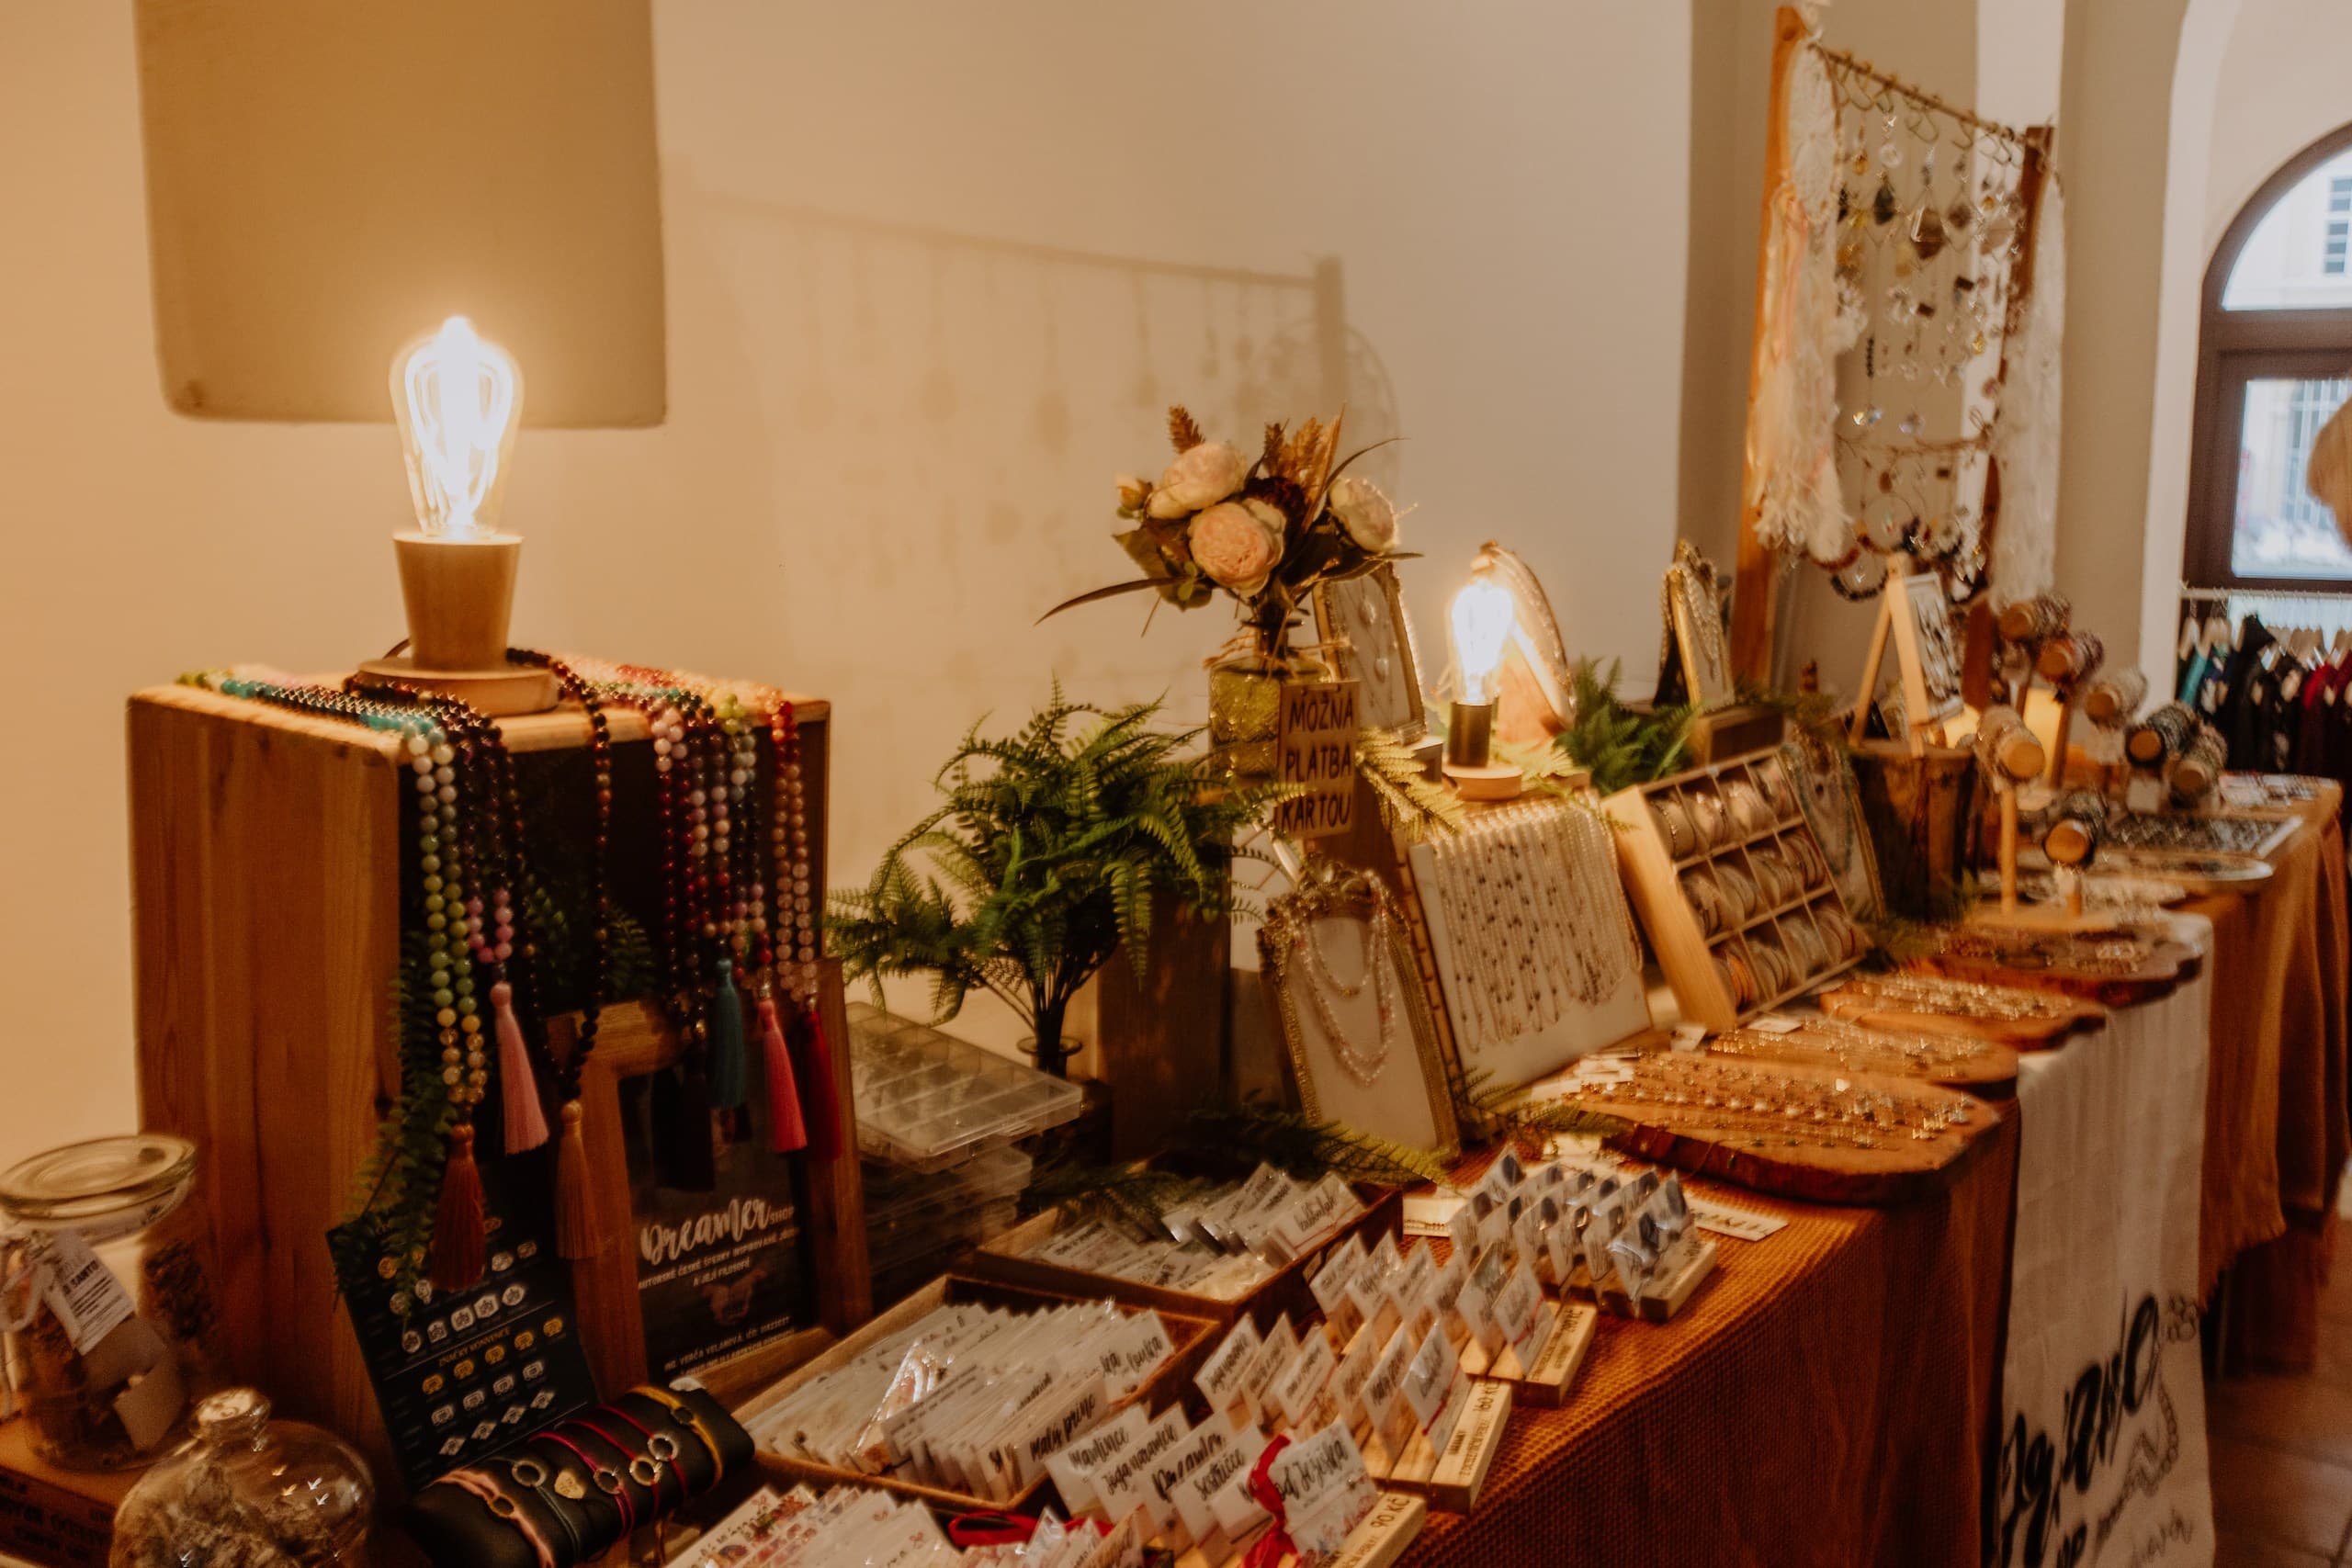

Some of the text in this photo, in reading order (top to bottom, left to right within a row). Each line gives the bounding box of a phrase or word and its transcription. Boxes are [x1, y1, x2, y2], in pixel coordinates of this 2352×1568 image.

[1288, 691, 1353, 734] MOŽNÁ
[1285, 742, 1351, 783] PLATBA
[1281, 793, 1351, 831] KARTOU
[640, 1198, 771, 1266] Dreamer
[1062, 1393, 1096, 1443] princ
[1370, 1513, 1395, 1529] 90
